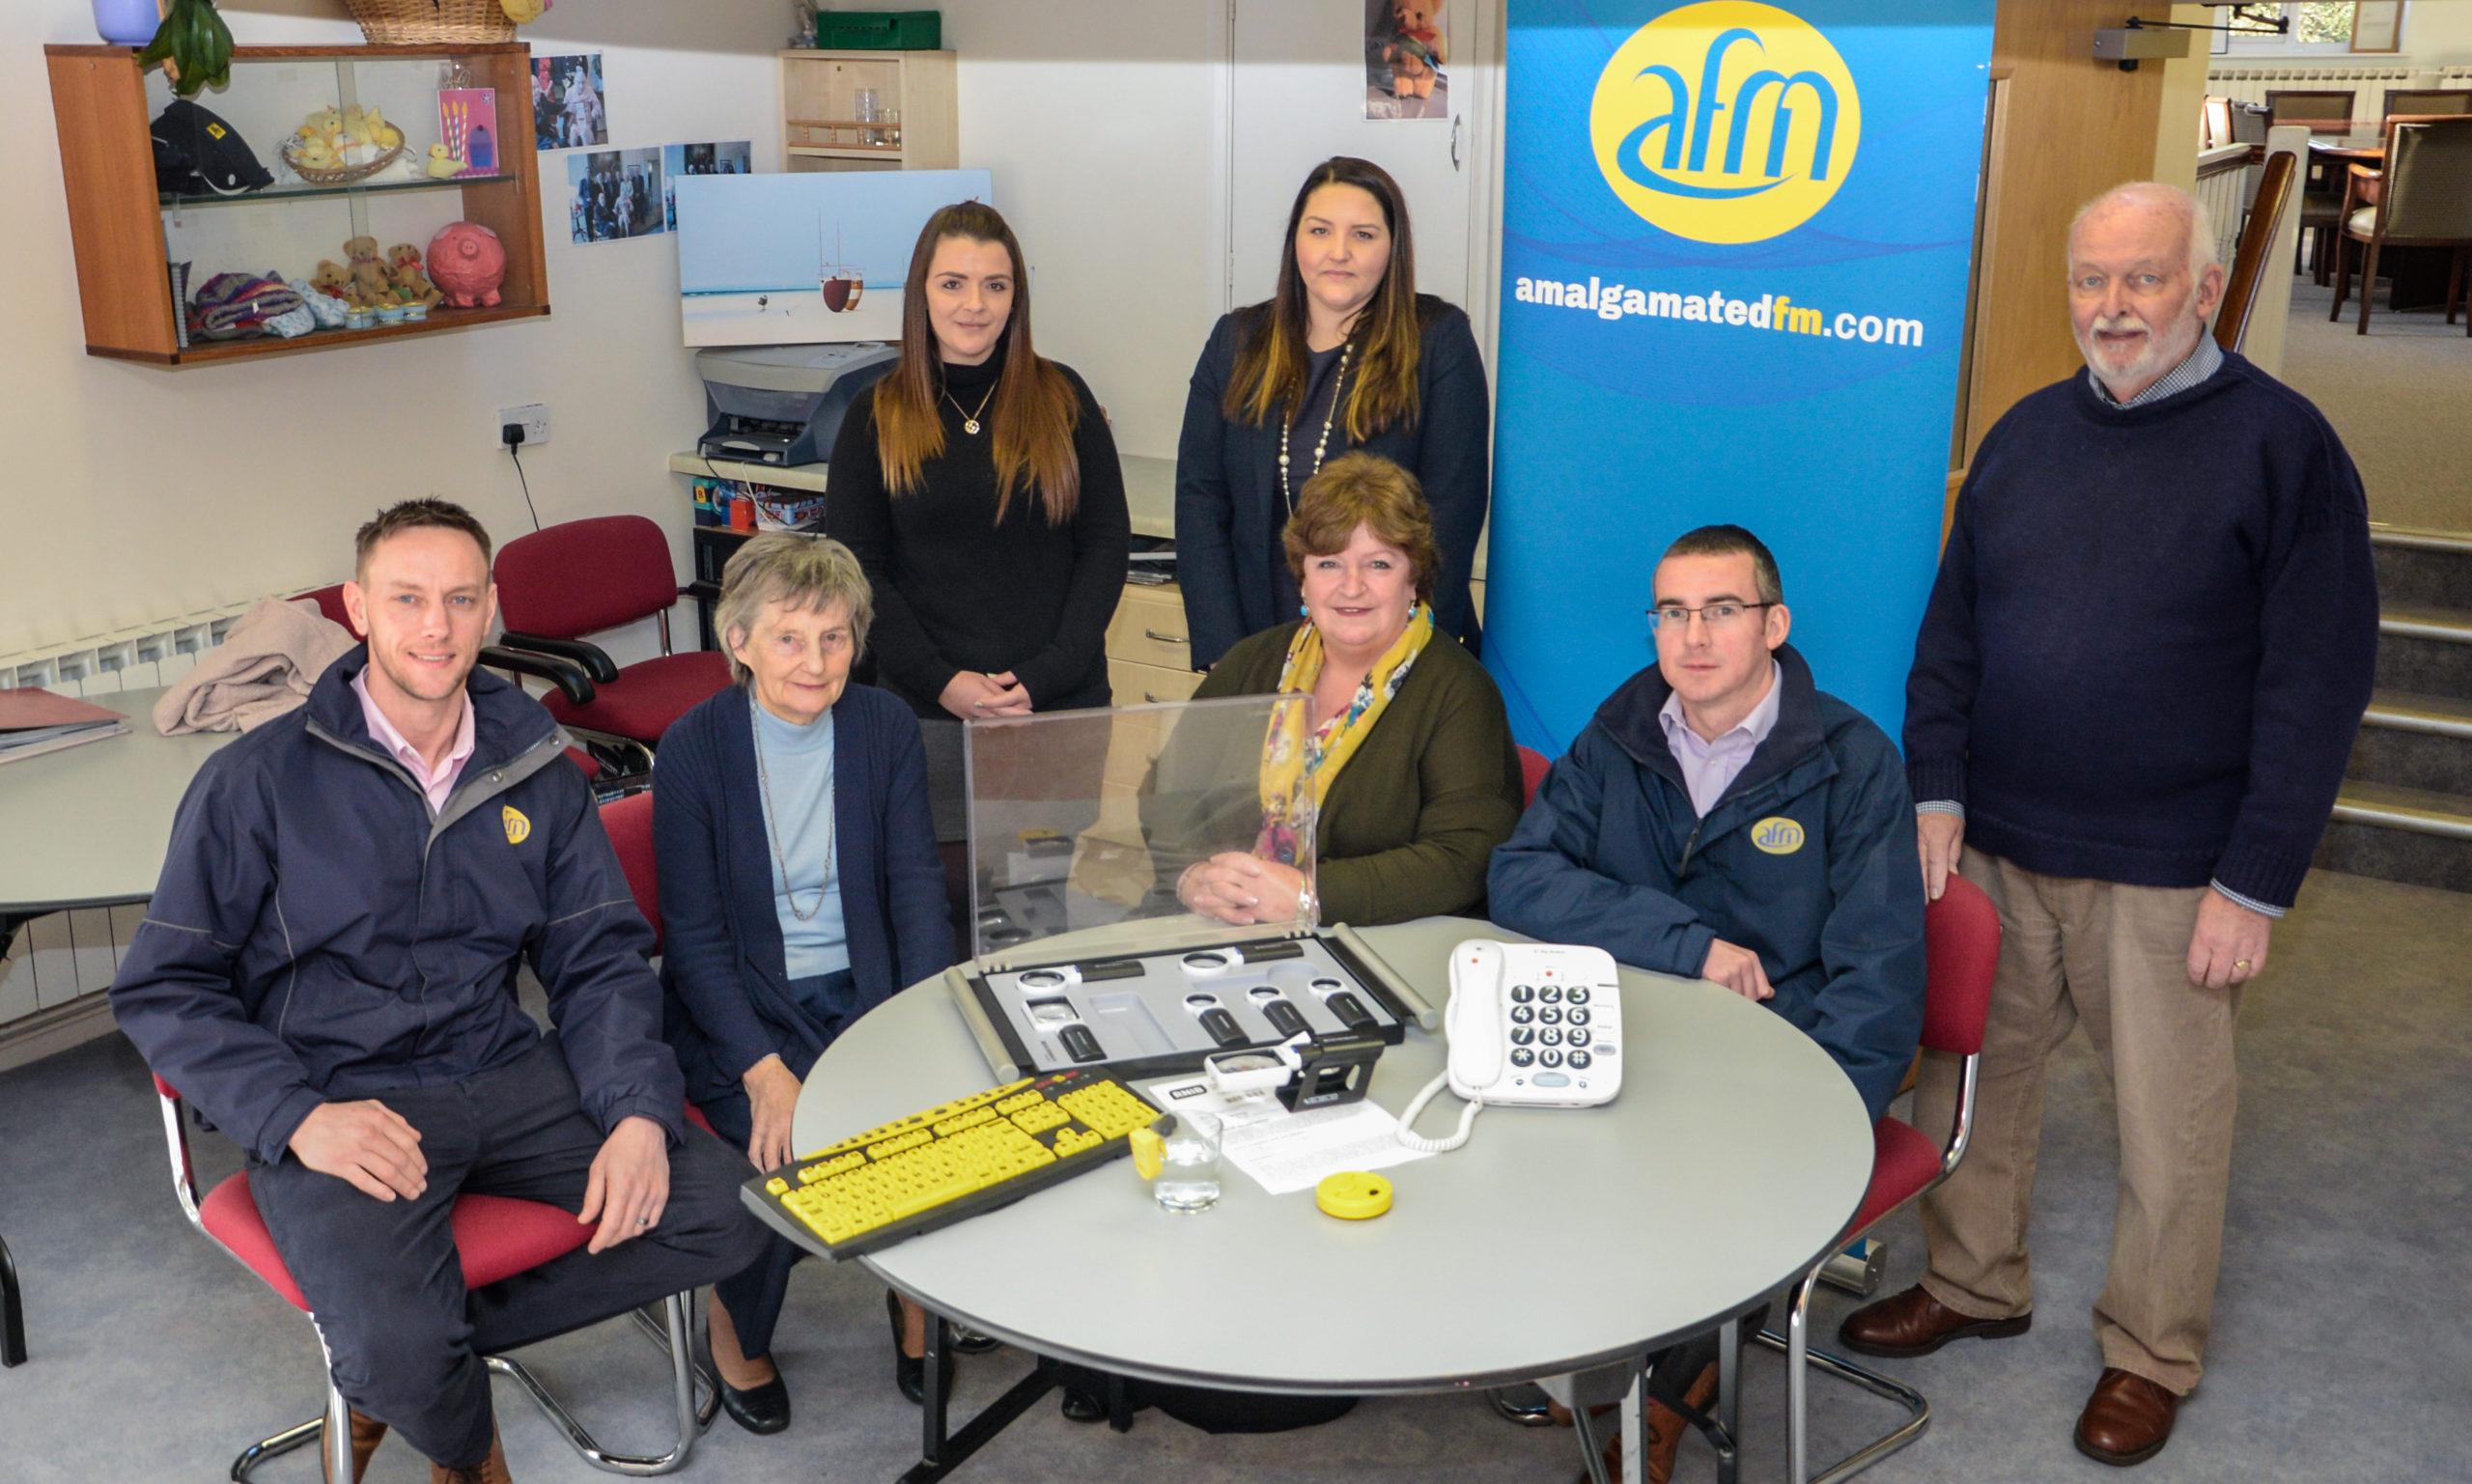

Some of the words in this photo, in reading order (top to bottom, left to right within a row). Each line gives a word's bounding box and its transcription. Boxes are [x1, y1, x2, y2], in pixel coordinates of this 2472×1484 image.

[1616, 28, 1839, 199] afm
[1515, 276, 1924, 347] amalgamatedfm.com
[1757, 822, 1800, 848] afm
[1517, 985, 1527, 1000] 1
[1544, 985, 1558, 1001] 2
[1572, 986, 1586, 1002] 3
[1514, 1005, 1530, 1021] 4
[1544, 1005, 1558, 1022] 5
[1571, 1007, 1585, 1023] 6
[1516, 1025, 1530, 1043] 7
[1544, 1026, 1559, 1044] 8
[1572, 1027, 1587, 1045] 9
[1544, 1048, 1559, 1065] 0
